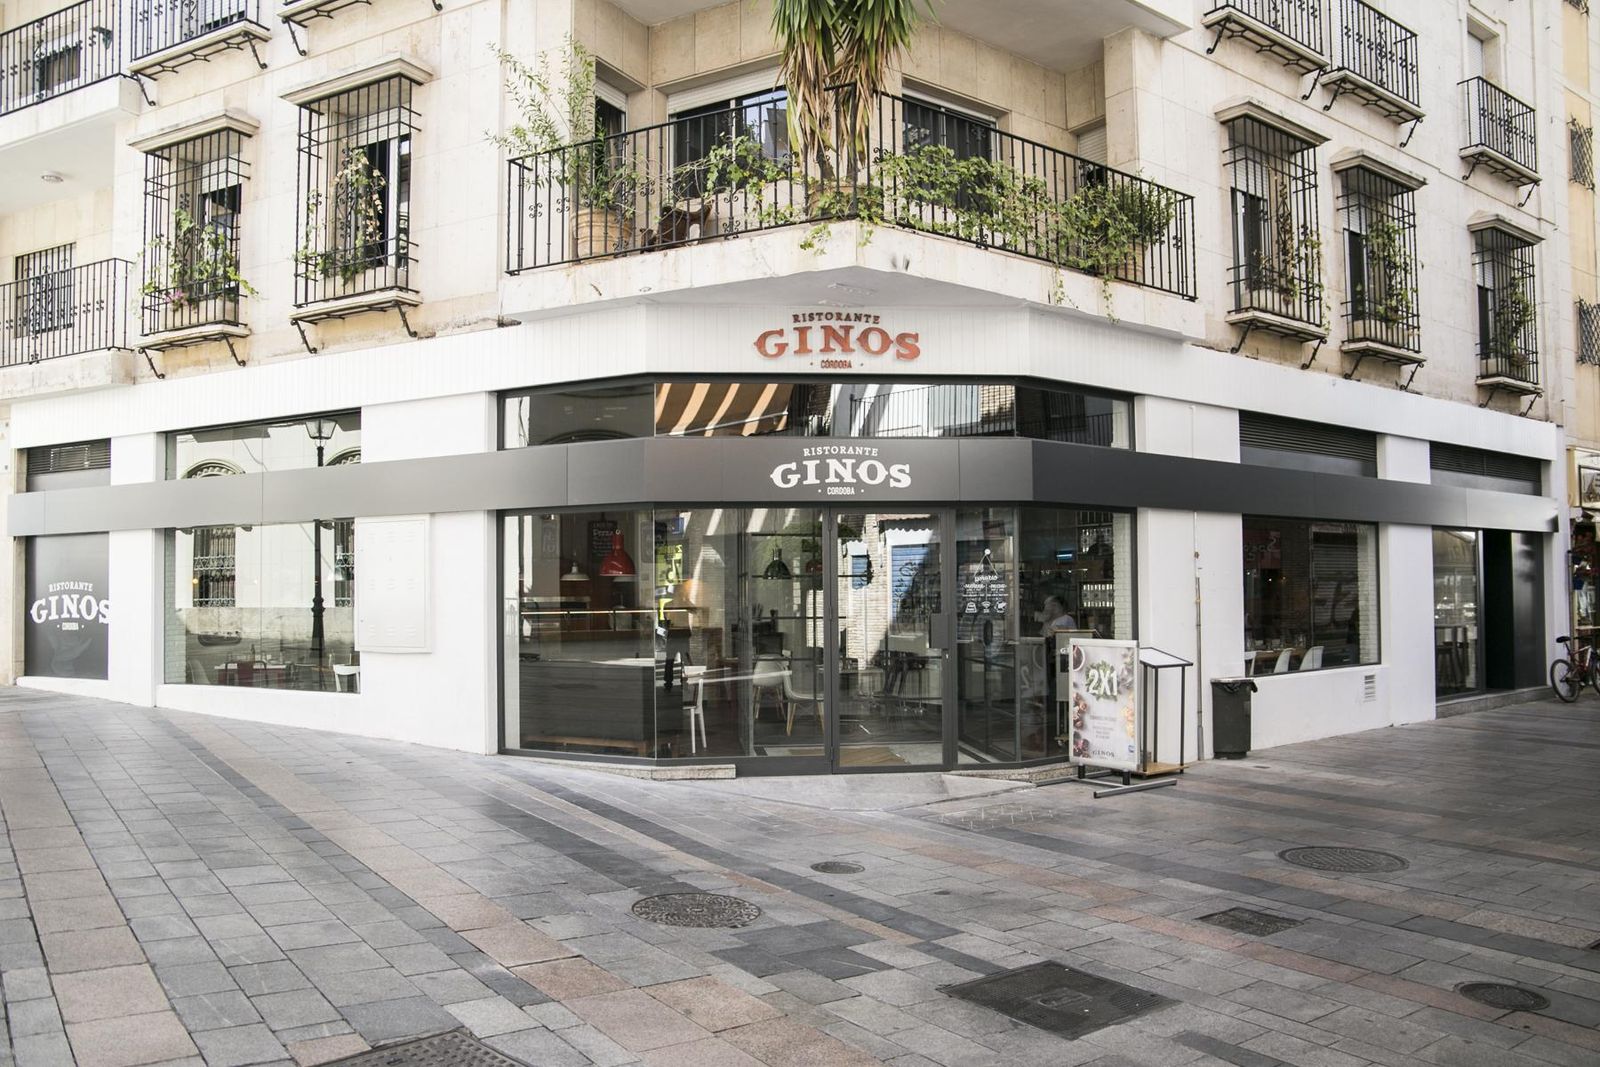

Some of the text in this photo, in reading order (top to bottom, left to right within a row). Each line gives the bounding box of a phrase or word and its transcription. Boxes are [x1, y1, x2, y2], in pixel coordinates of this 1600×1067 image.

[792, 312, 881, 324] RISTORANTE
[753, 325, 921, 361] GINOS
[803, 446, 879, 457] RISTORANTE
[770, 458, 912, 488] GINOS
[48, 581, 93, 592] RISTORANTE
[30, 594, 111, 624] GINOS
